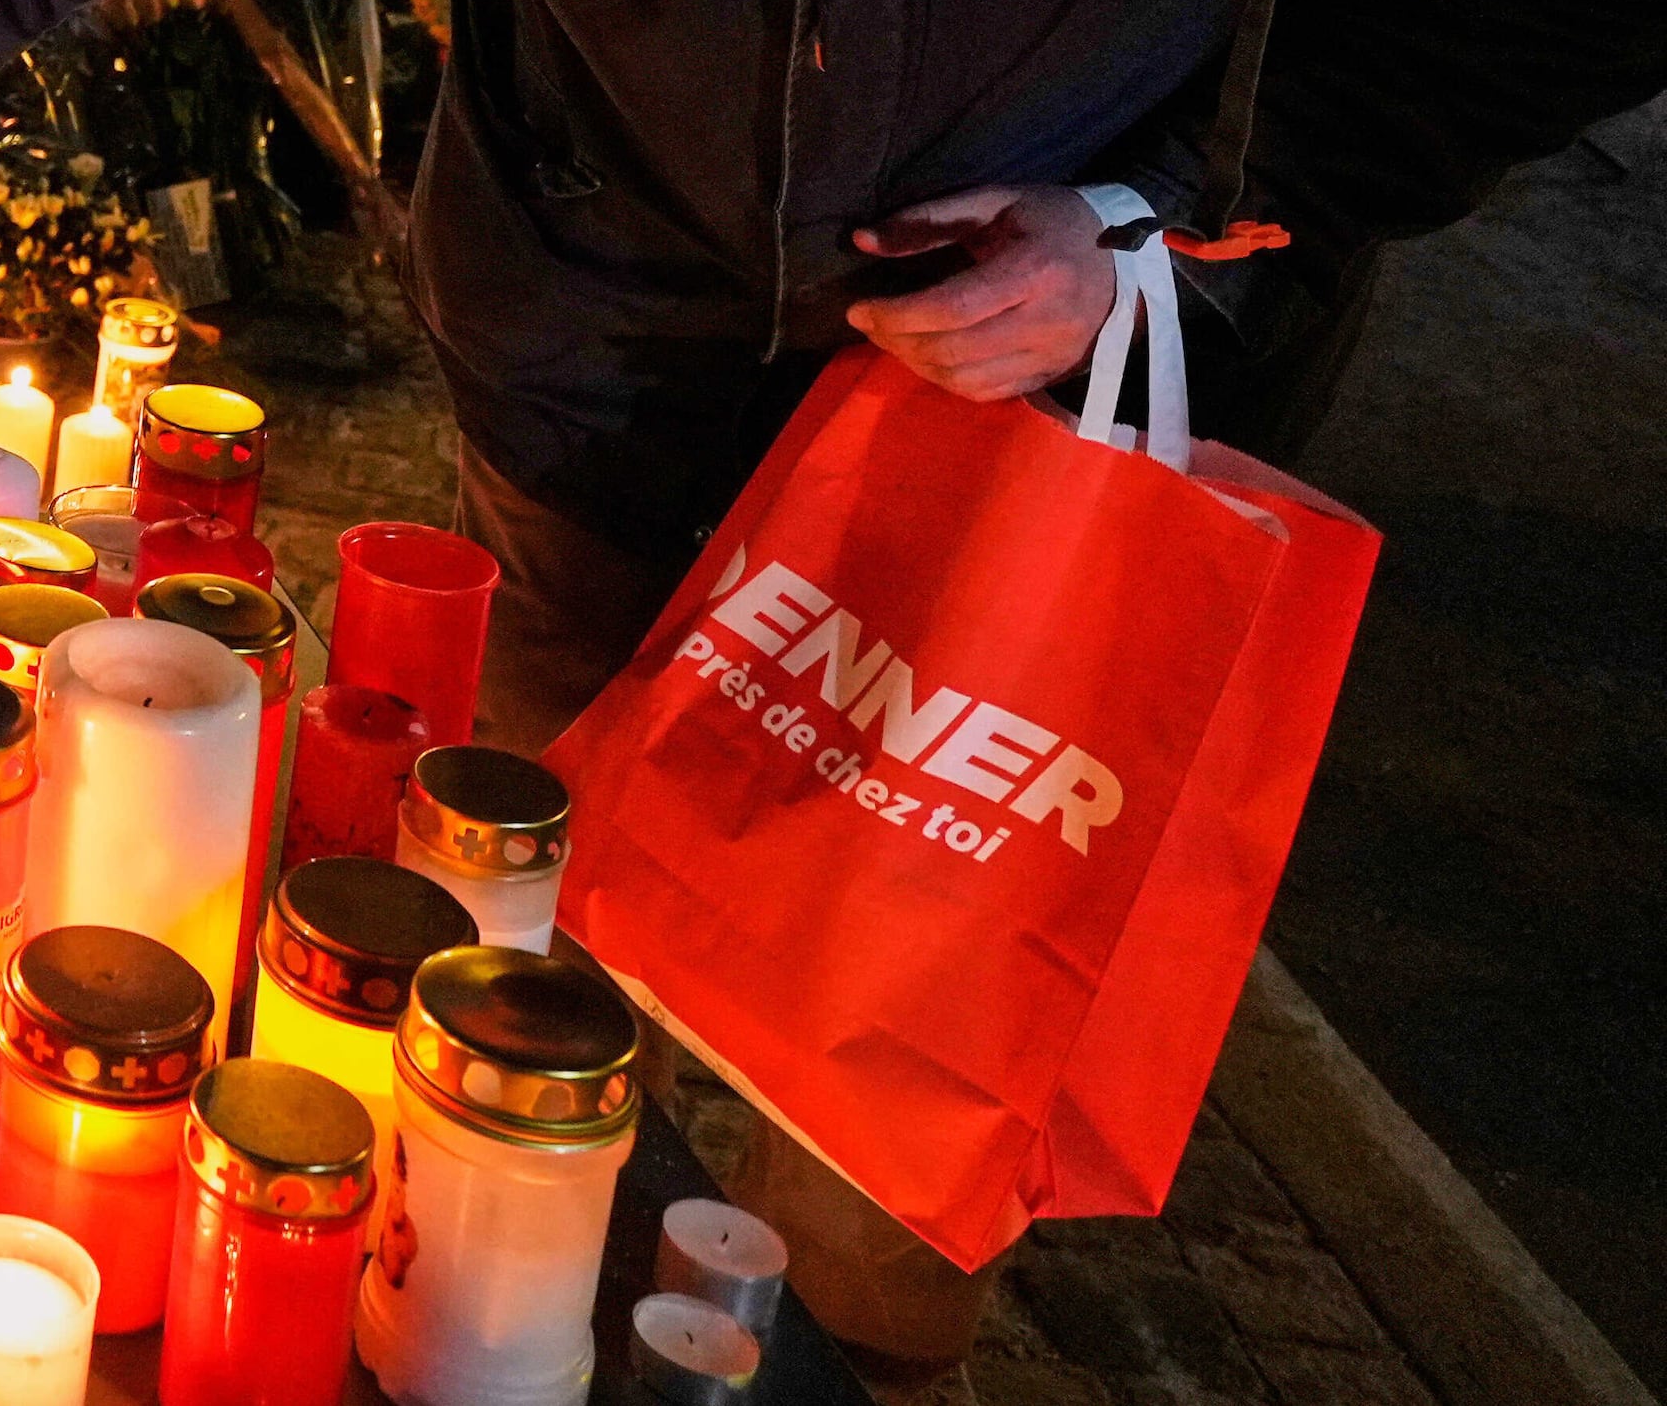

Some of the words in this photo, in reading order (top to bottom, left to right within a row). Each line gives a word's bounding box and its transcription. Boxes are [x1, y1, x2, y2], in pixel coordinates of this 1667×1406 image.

[674, 630, 765, 712] Près
[761, 702, 817, 754] de
[815, 747, 922, 827] chez
[921, 803, 1012, 863] toi
